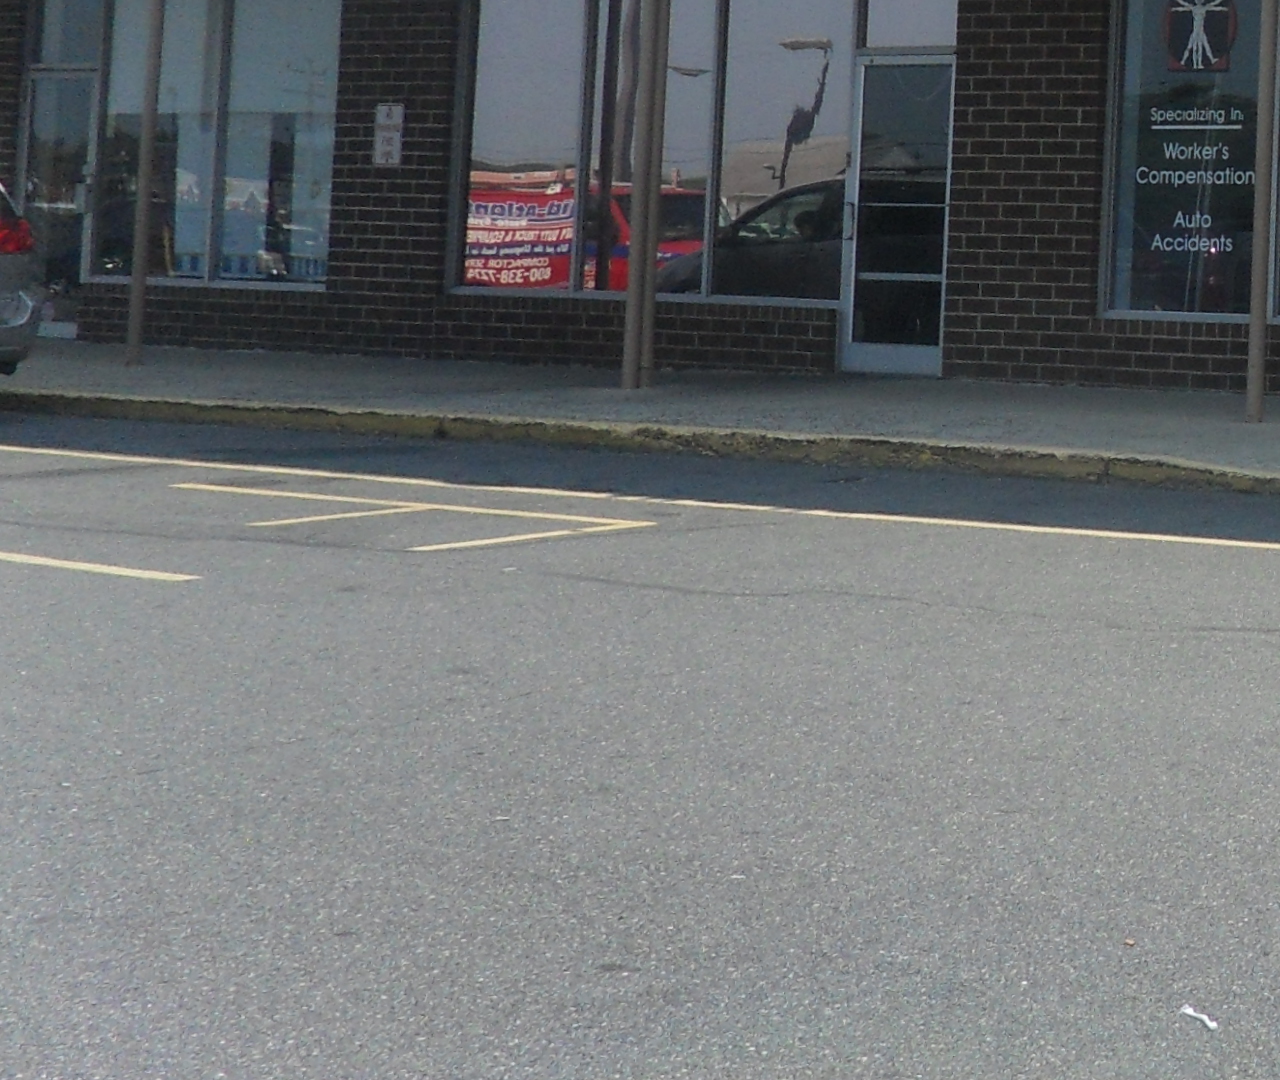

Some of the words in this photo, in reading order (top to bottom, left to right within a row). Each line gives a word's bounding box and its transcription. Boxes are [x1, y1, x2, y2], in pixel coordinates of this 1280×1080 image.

[1150, 107, 1226, 124] Specializing
[1163, 142, 1230, 160] Worker's
[1135, 167, 1256, 188] Compensation
[1173, 211, 1212, 229] Auto
[1151, 234, 1233, 252] Accidents
